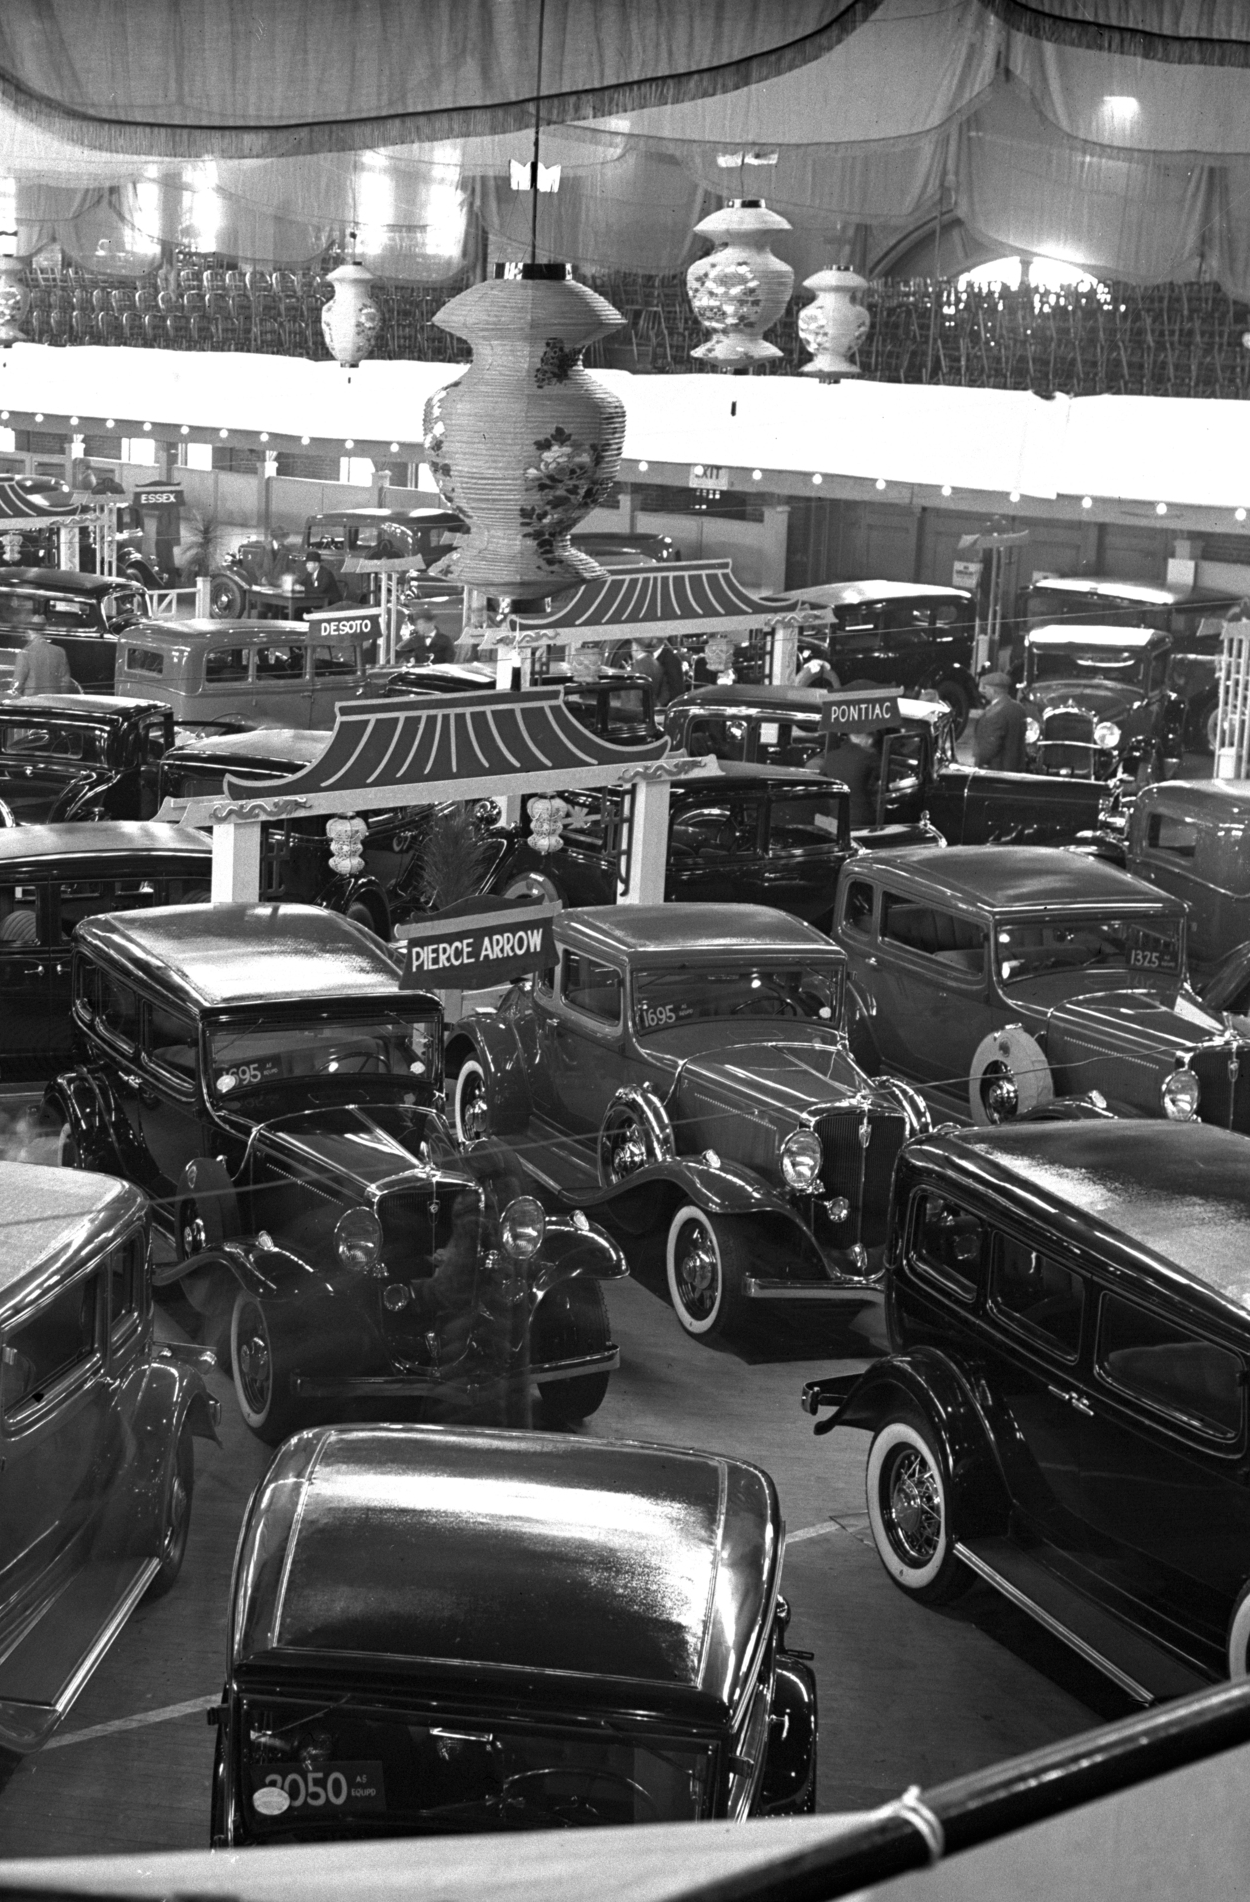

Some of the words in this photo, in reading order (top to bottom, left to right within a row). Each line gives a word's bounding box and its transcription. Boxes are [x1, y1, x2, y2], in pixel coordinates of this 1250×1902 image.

[695, 466, 723, 480] XIT
[141, 493, 176, 504] ESSEX
[321, 619, 372, 636] DESOTO
[831, 702, 891, 723] PONTIAC
[412, 938, 476, 972] PIERCE
[479, 928, 543, 961] ARROW
[1131, 949, 1160, 968] 1325
[642, 1004, 677, 1028] 1695
[222, 1063, 262, 1087] 695
[355, 1774, 368, 1784] AS
